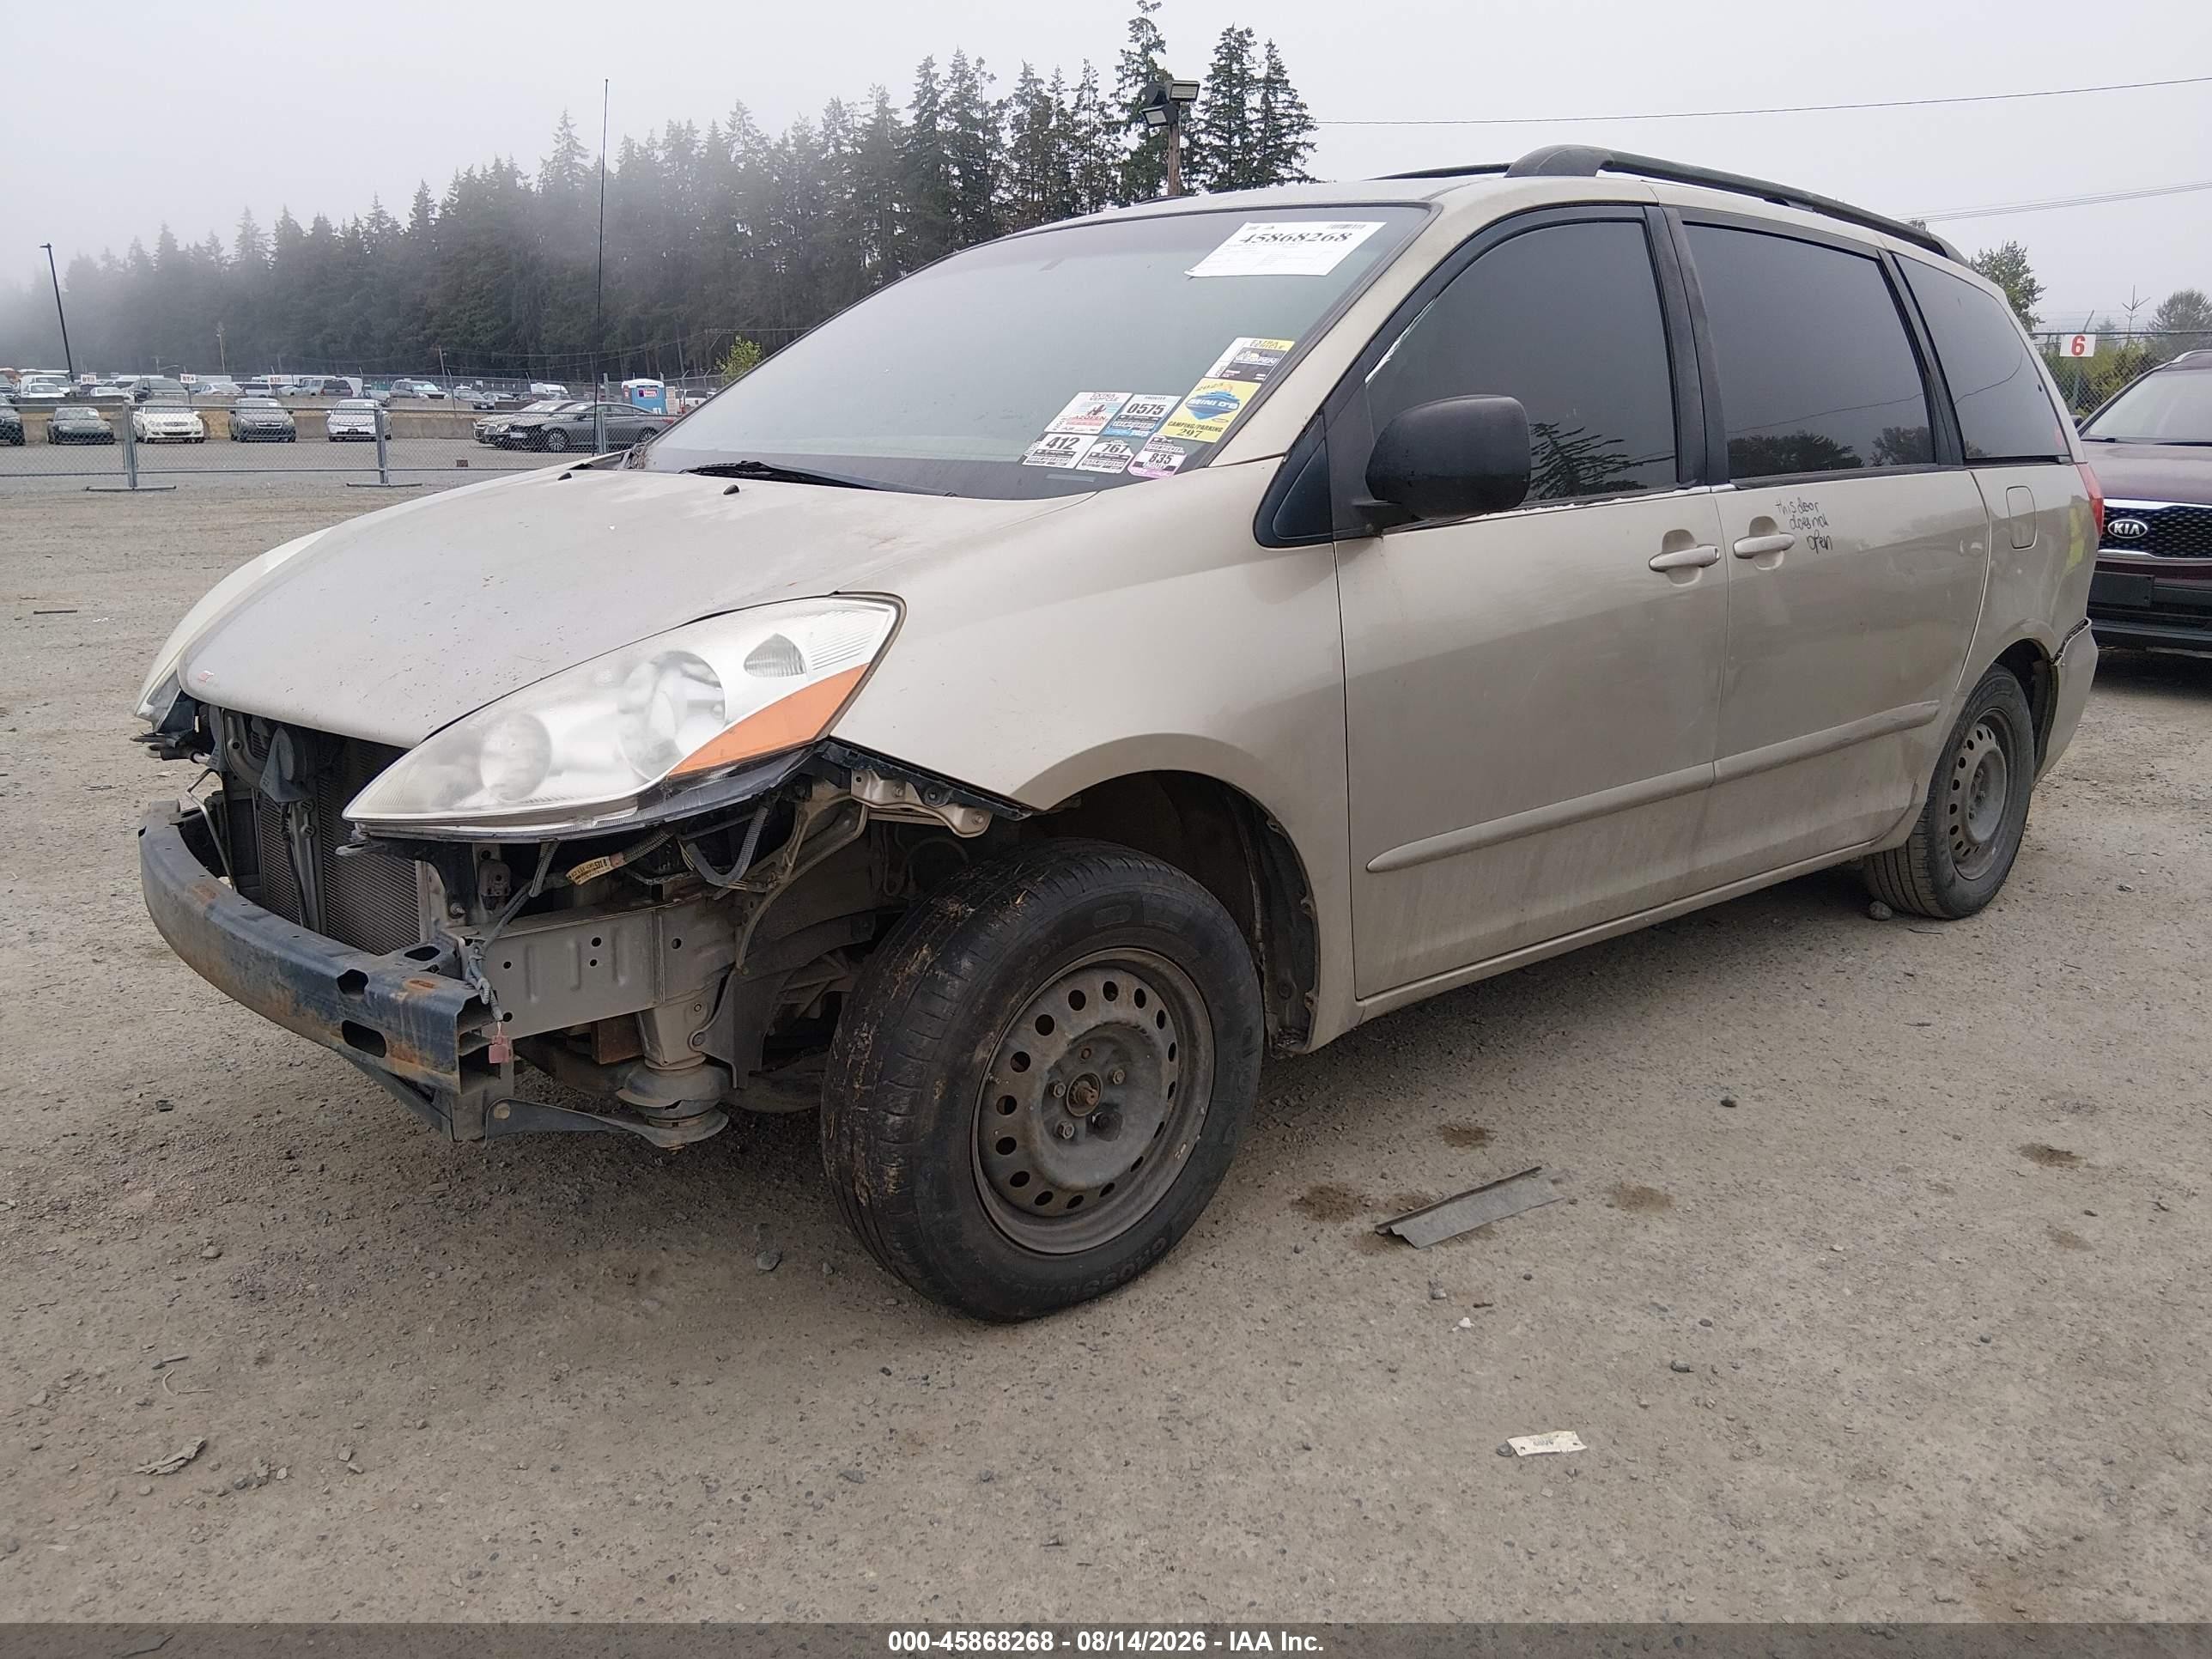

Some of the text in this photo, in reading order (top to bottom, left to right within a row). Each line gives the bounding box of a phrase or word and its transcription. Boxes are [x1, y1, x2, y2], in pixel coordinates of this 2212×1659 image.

[1239, 232, 1352, 244] 45868268
[2070, 335, 2085, 356] 6
[1126, 403, 1166, 415] 0575
[1176, 428, 1203, 438] 297
[1045, 436, 1080, 450] 412
[1102, 443, 1129, 453] 767
[1148, 453, 1174, 465] 835
[2113, 522, 2141, 535] KIA
